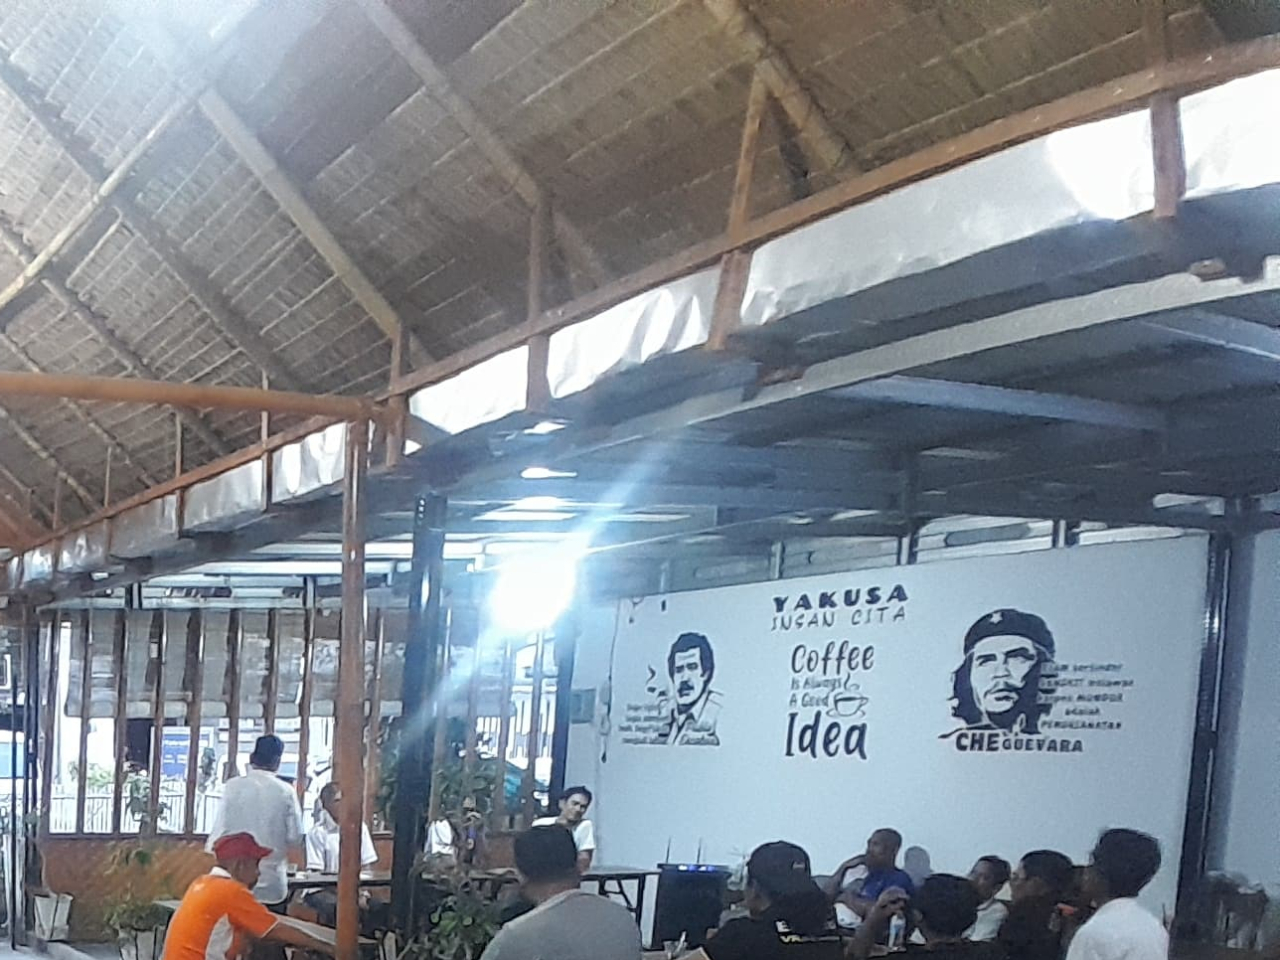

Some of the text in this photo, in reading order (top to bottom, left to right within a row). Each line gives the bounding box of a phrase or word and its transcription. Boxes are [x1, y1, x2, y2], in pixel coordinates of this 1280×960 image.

[773, 584, 908, 613] YAKUSA
[851, 605, 906, 626] CITA
[791, 640, 875, 676] Coffee
[789, 693, 798, 707] A
[785, 710, 867, 760] Idea
[956, 732, 1084, 752] CHE GUEVARA
